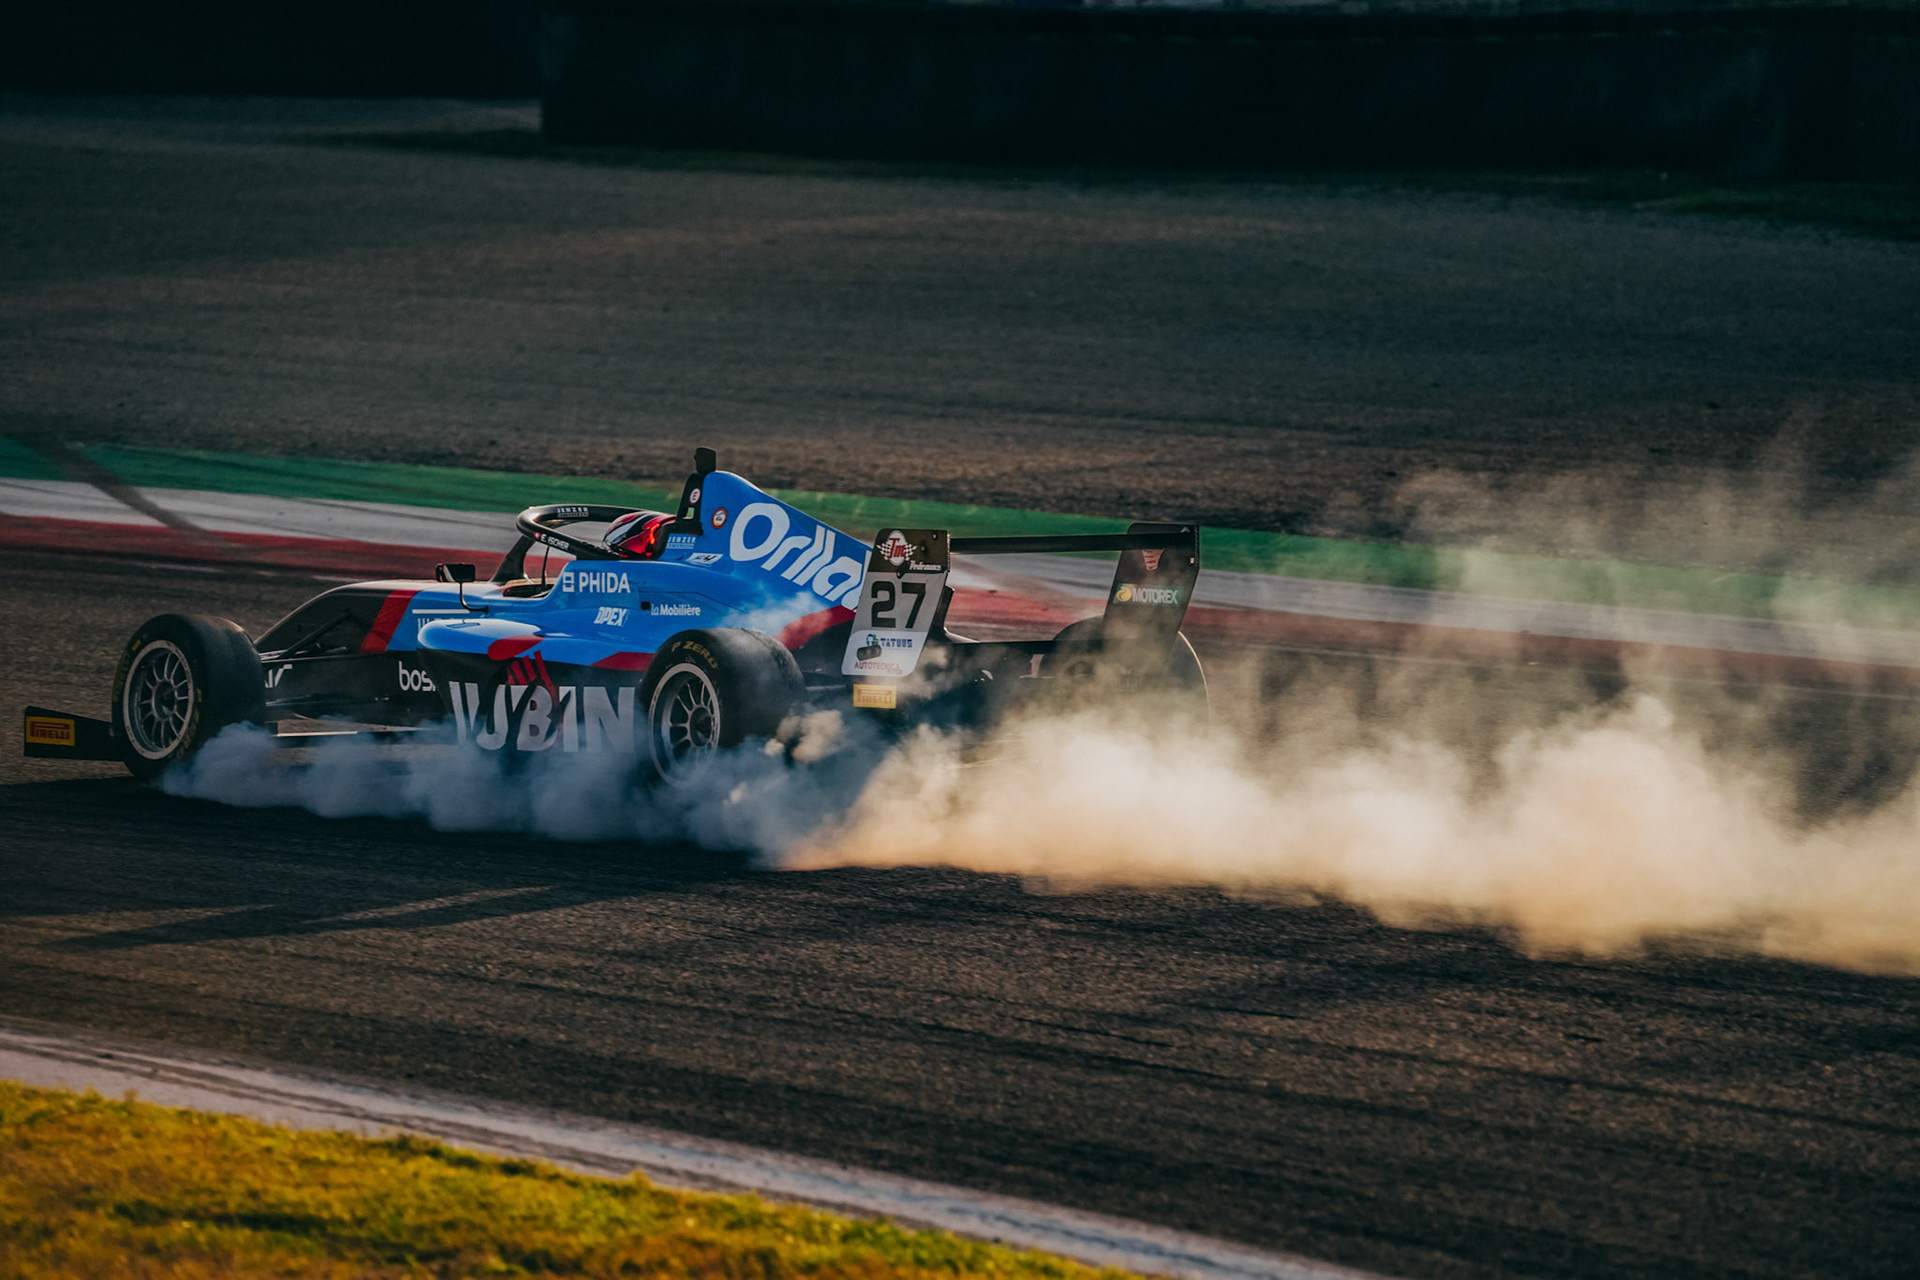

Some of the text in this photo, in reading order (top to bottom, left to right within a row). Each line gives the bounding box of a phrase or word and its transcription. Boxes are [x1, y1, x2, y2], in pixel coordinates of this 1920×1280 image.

[578, 572, 631, 593] PHIDA
[871, 581, 926, 629] 27
[1132, 587, 1178, 605] MOTOREX
[651, 604, 701, 616] la Mobilière
[880, 638, 913, 648] TATUUS
[682, 640, 719, 669] ZERO
[398, 660, 436, 692] bos
[856, 688, 893, 705] PIRELLI
[29, 721, 70, 740] PIRELLI
